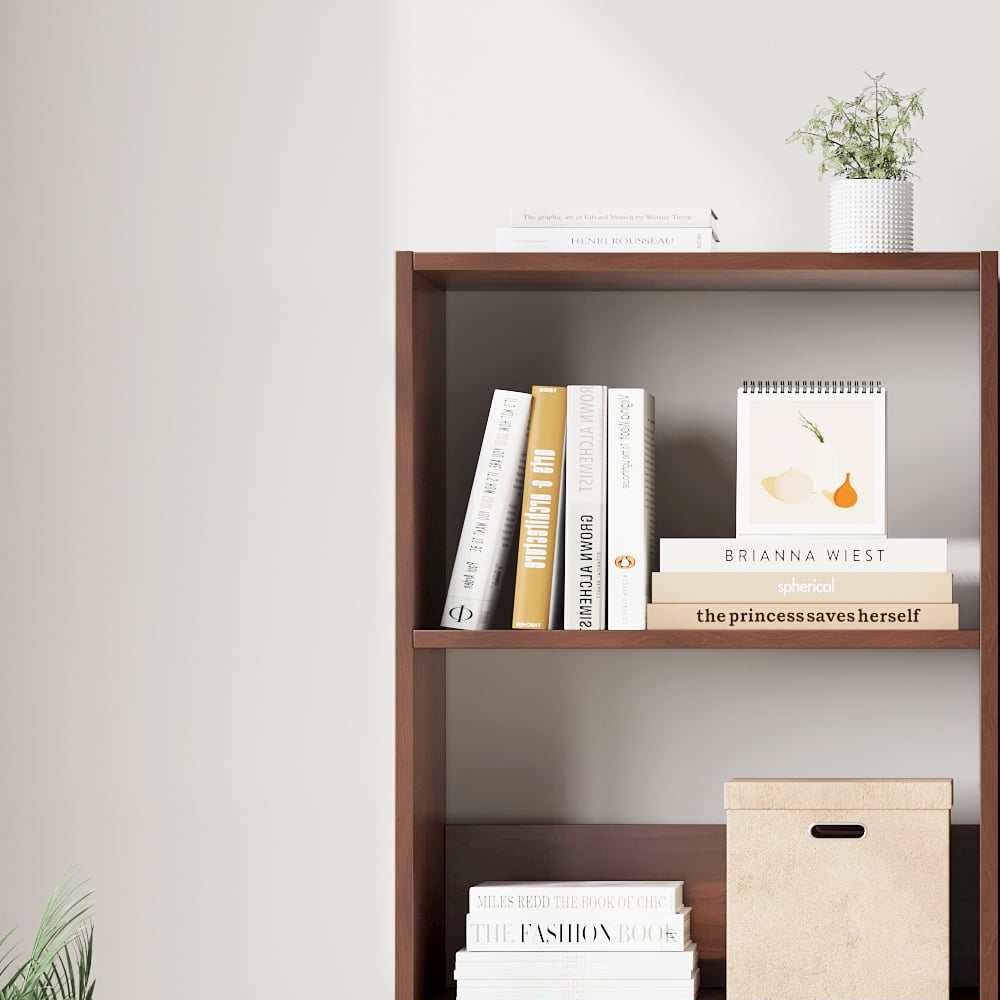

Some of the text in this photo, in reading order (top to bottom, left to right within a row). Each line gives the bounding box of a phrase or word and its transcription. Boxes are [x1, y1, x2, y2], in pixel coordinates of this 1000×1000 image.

[725, 549, 885, 562] BRIANNA WIEST
[777, 576, 835, 597] spherical
[697, 609, 921, 626] the princess saves herself
[477, 895, 666, 909] MILES REDD THE BOOK OF CHIC
[471, 923, 678, 943] THE FASHION BOOK
